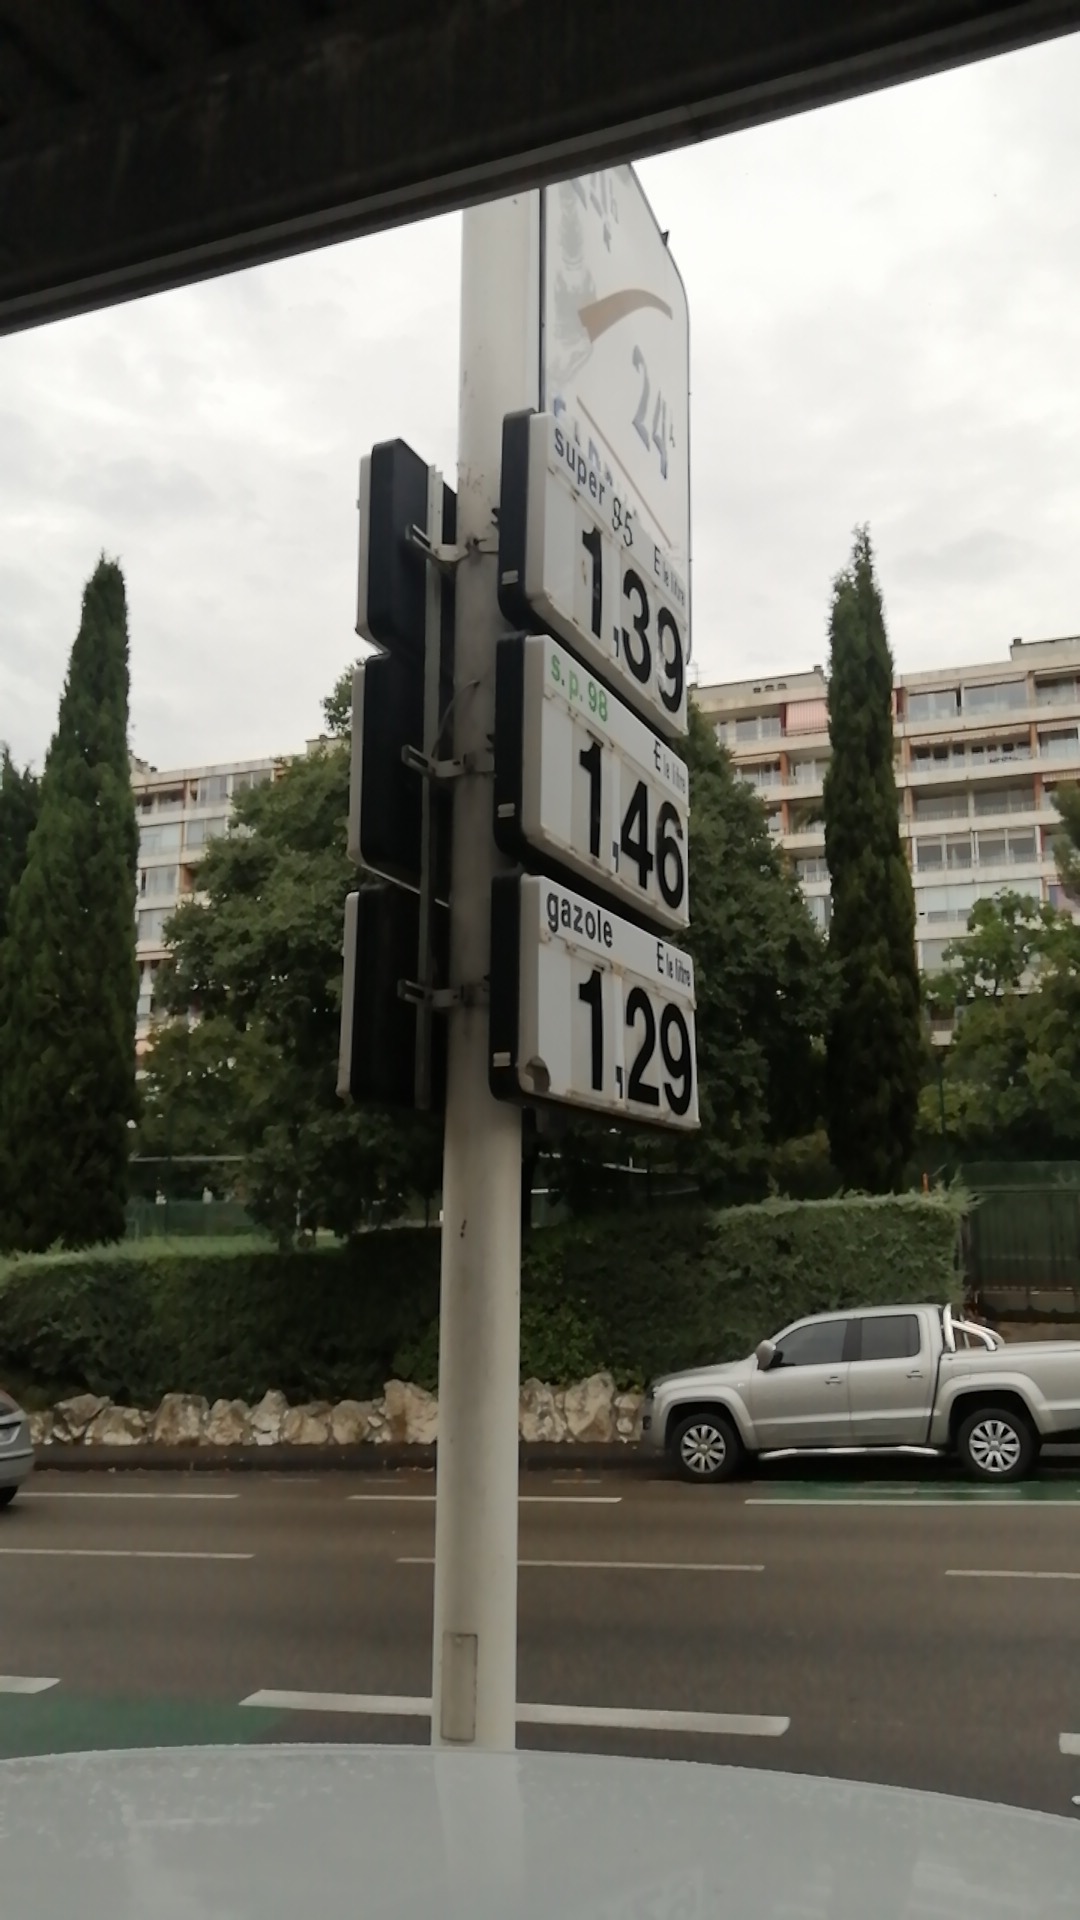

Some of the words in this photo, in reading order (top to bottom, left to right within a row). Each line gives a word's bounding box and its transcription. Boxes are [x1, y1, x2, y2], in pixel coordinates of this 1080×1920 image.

[553, 427, 605, 506] super
[582, 526, 684, 714] 1,39
[579, 741, 684, 909] 1,46
[546, 892, 613, 948] gazole
[579, 969, 692, 1116] 1,29
